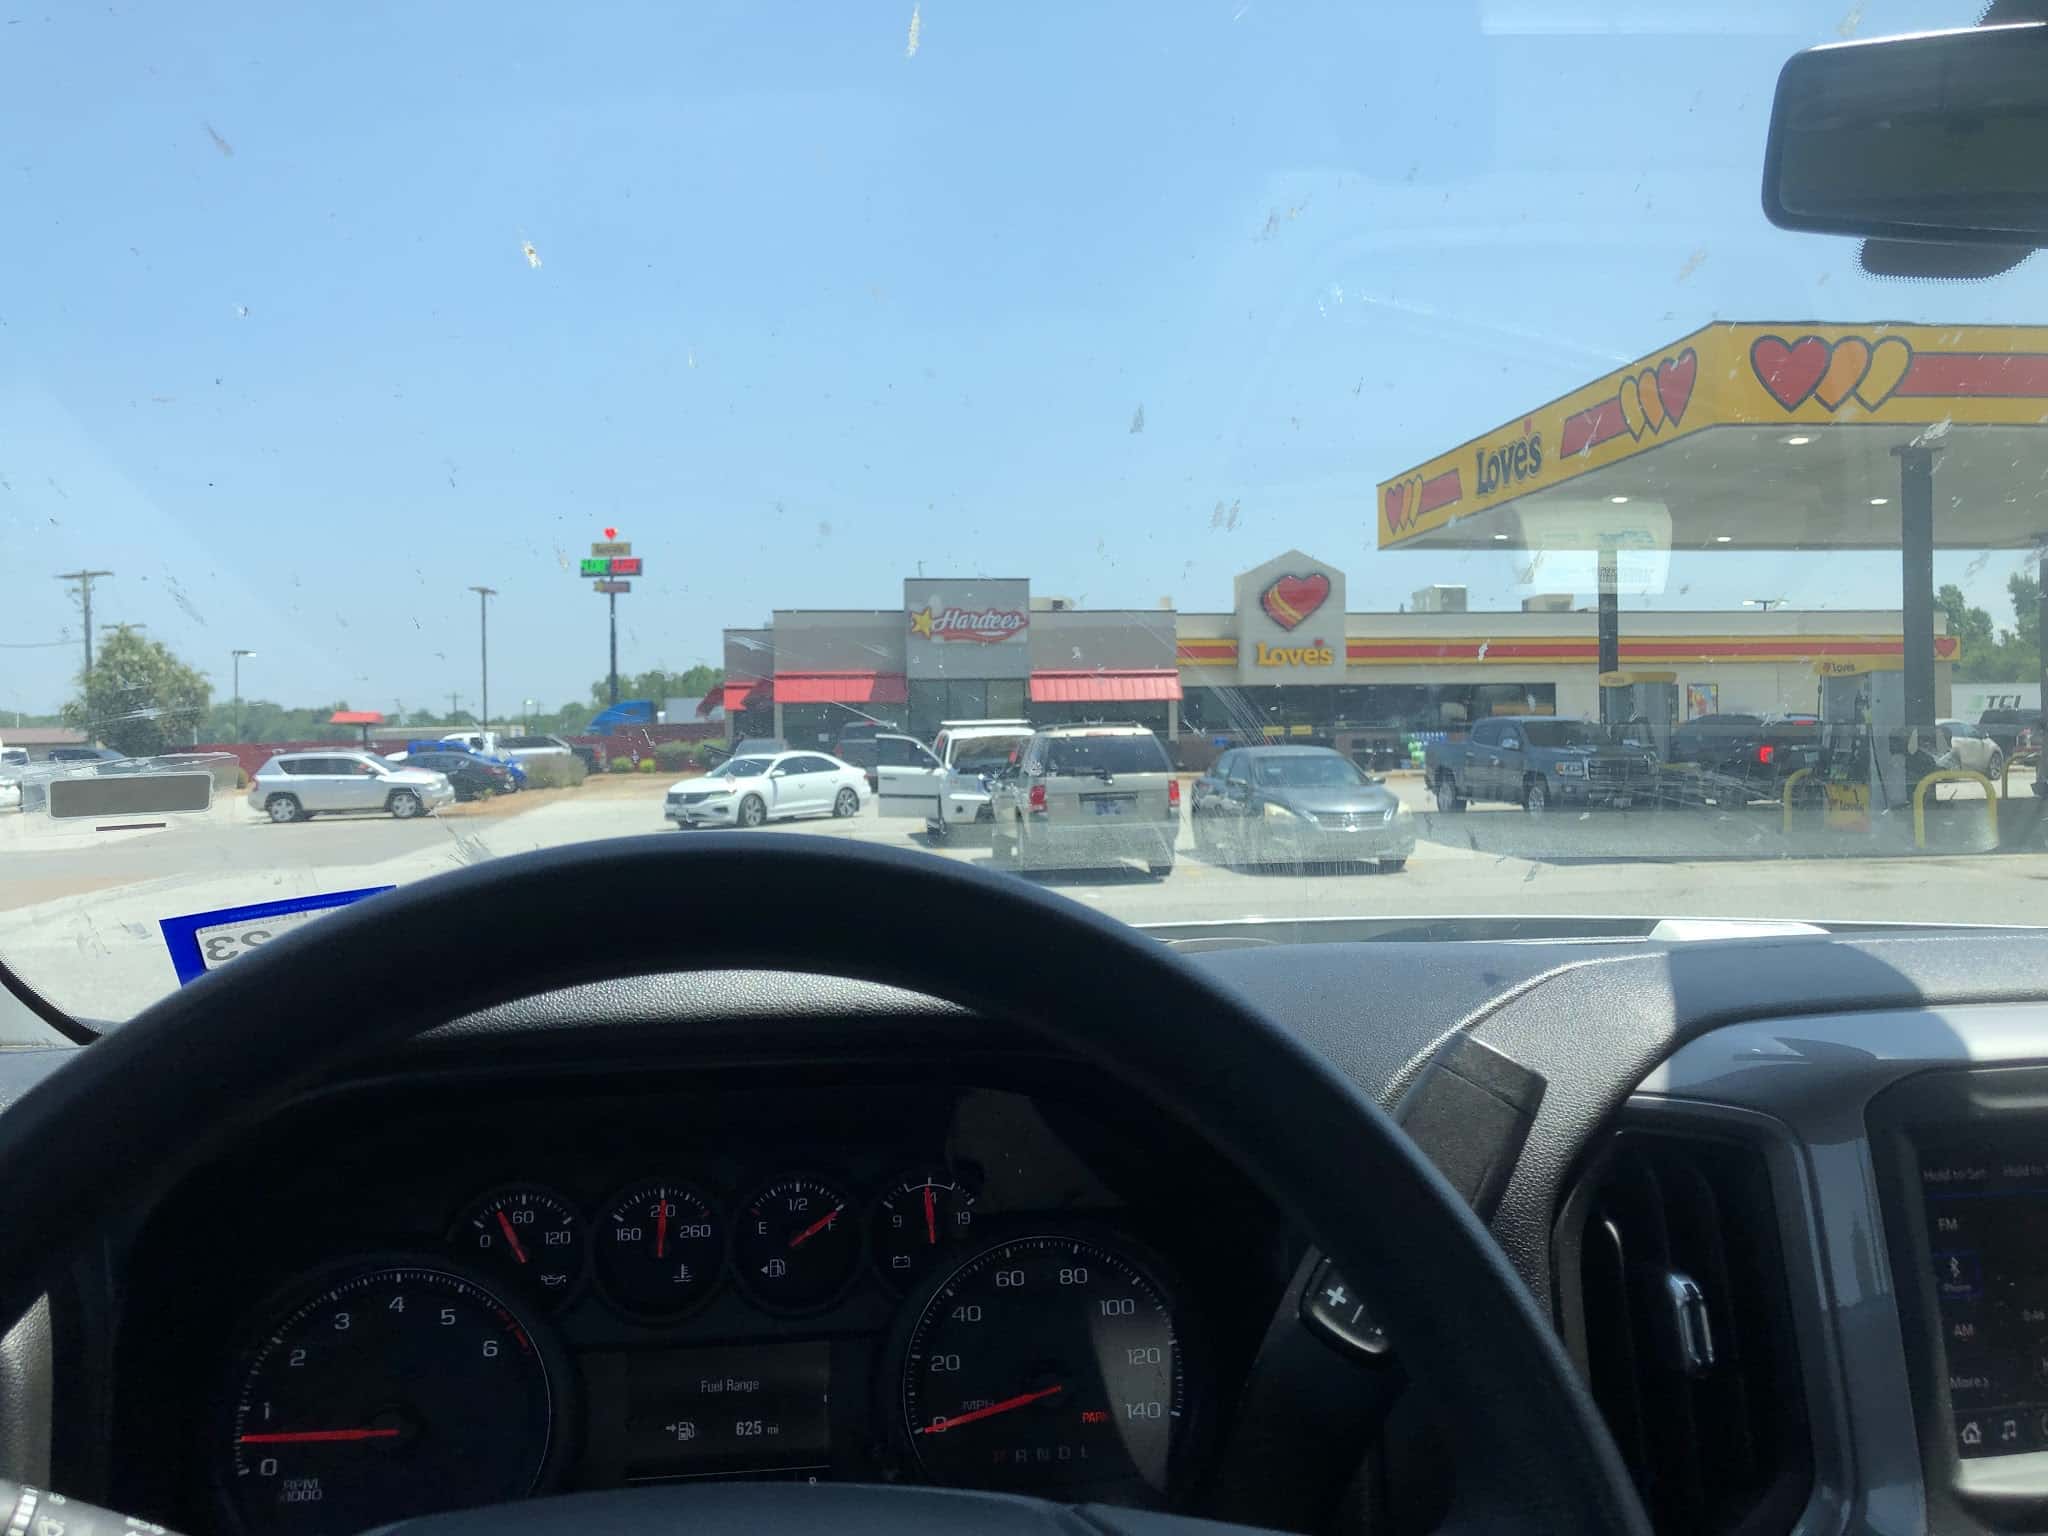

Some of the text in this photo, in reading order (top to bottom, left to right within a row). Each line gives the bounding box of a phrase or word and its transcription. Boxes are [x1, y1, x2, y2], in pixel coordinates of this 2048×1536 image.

[512, 1209, 535, 1224] 60
[892, 1215, 902, 1228] 9
[957, 1211, 971, 1225] 19
[616, 1227, 642, 1241] 160
[680, 1224, 711, 1239] 260
[758, 1221, 768, 1235] E
[479, 1235, 491, 1248] 0
[545, 1231, 571, 1246] 120
[996, 1270, 1025, 1287] 60
[1058, 1268, 1088, 1285] 80
[389, 1296, 405, 1313] 4
[1100, 1298, 1135, 1316] 100
[334, 1312, 351, 1330] 3
[440, 1308, 456, 1326] 5
[952, 1305, 982, 1322] 40
[482, 1340, 498, 1357] 6
[1127, 1347, 1161, 1365] 120
[289, 1349, 306, 1367] 2
[931, 1354, 961, 1372] 20
[701, 1378, 760, 1394] Fuel Range
[263, 1402, 271, 1420] 1
[1125, 1401, 1161, 1420] 140
[736, 1420, 779, 1436] 625 mi
[260, 1458, 278, 1476] 0
